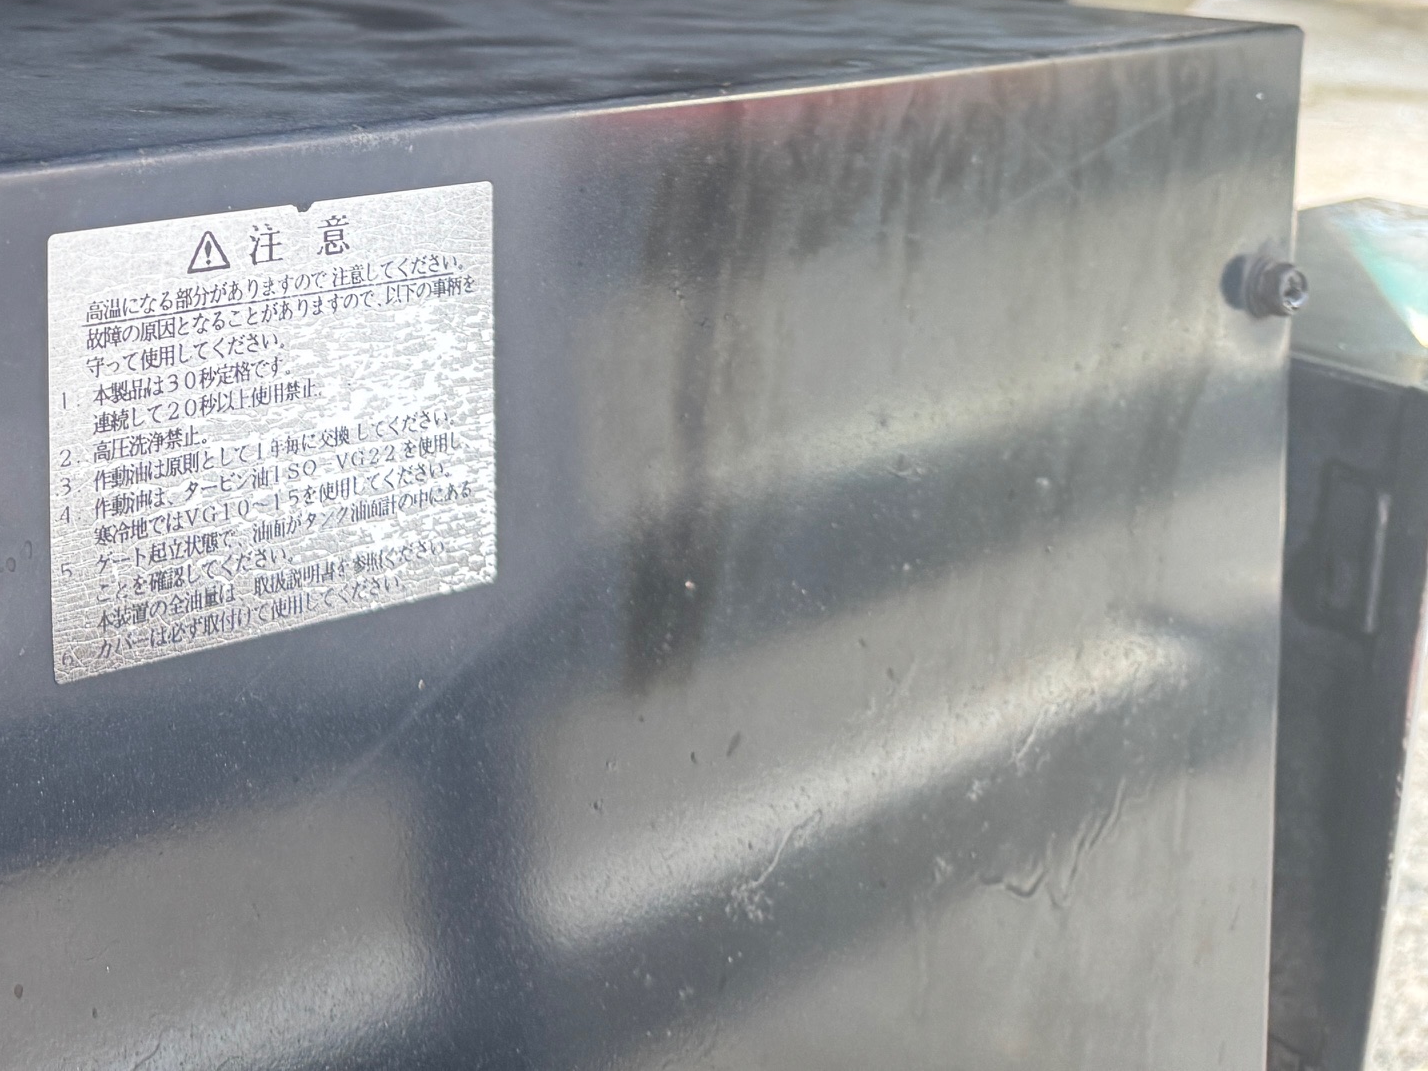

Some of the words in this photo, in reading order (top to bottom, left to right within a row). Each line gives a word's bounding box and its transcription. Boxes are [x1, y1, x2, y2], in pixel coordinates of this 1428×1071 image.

[86, 327, 285, 379] 守って使用してください。
